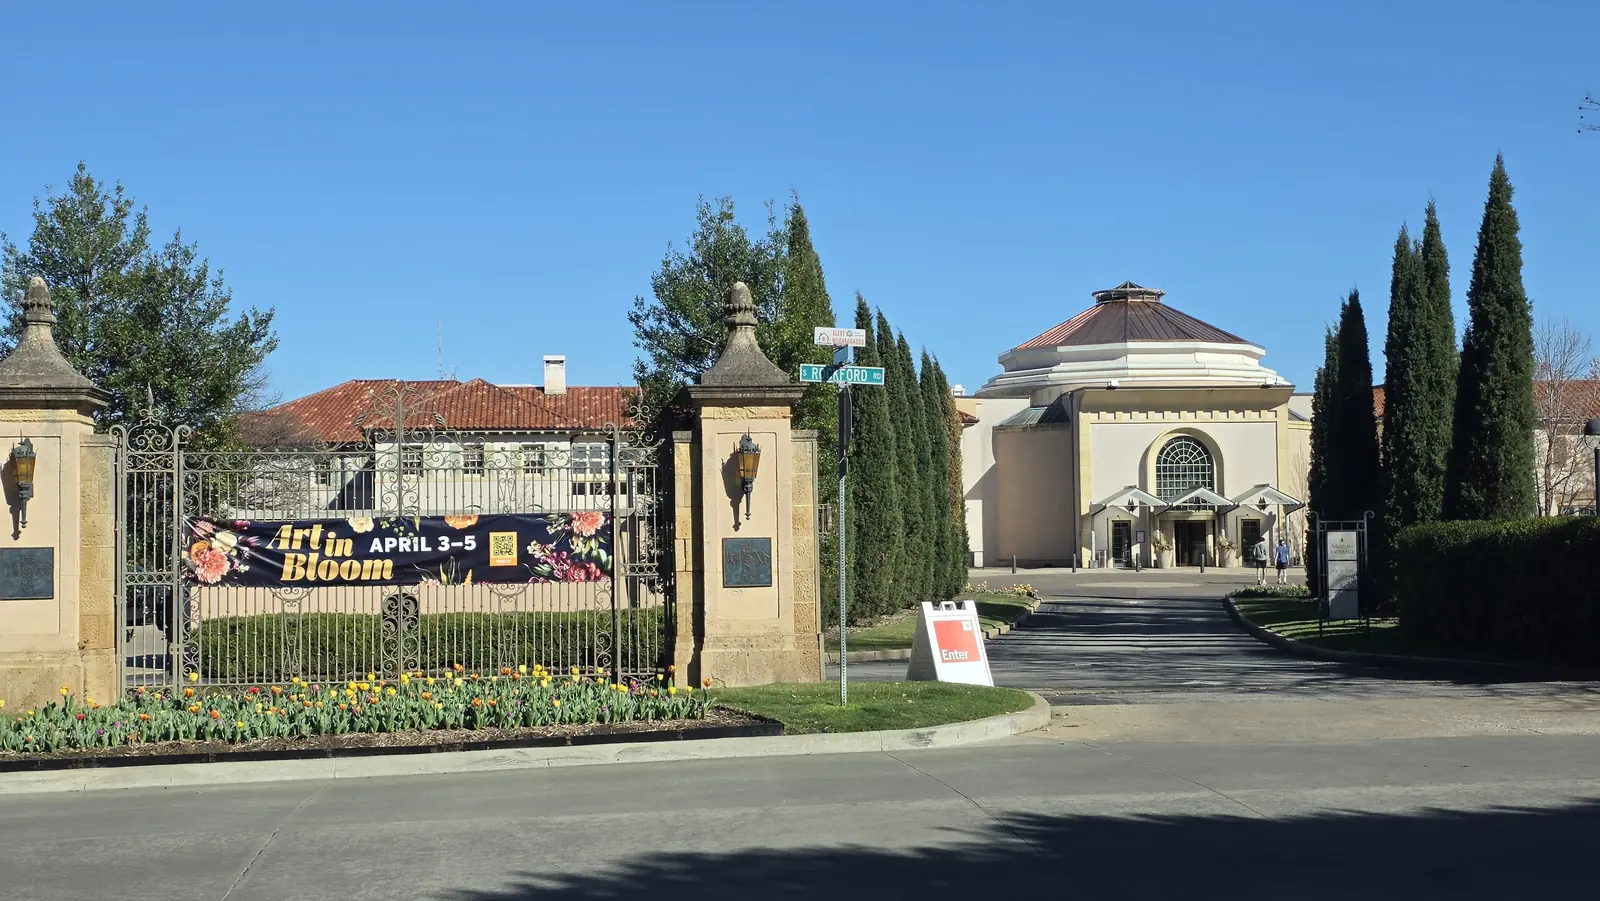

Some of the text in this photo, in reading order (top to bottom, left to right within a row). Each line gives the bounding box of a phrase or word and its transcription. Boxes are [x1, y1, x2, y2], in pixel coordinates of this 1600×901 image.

[872, 372, 882, 380] RD
[266, 524, 354, 557] Art in
[369, 536, 432, 553] APRIL
[280, 555, 394, 581] Bloom
[941, 649, 969, 661] Enter
